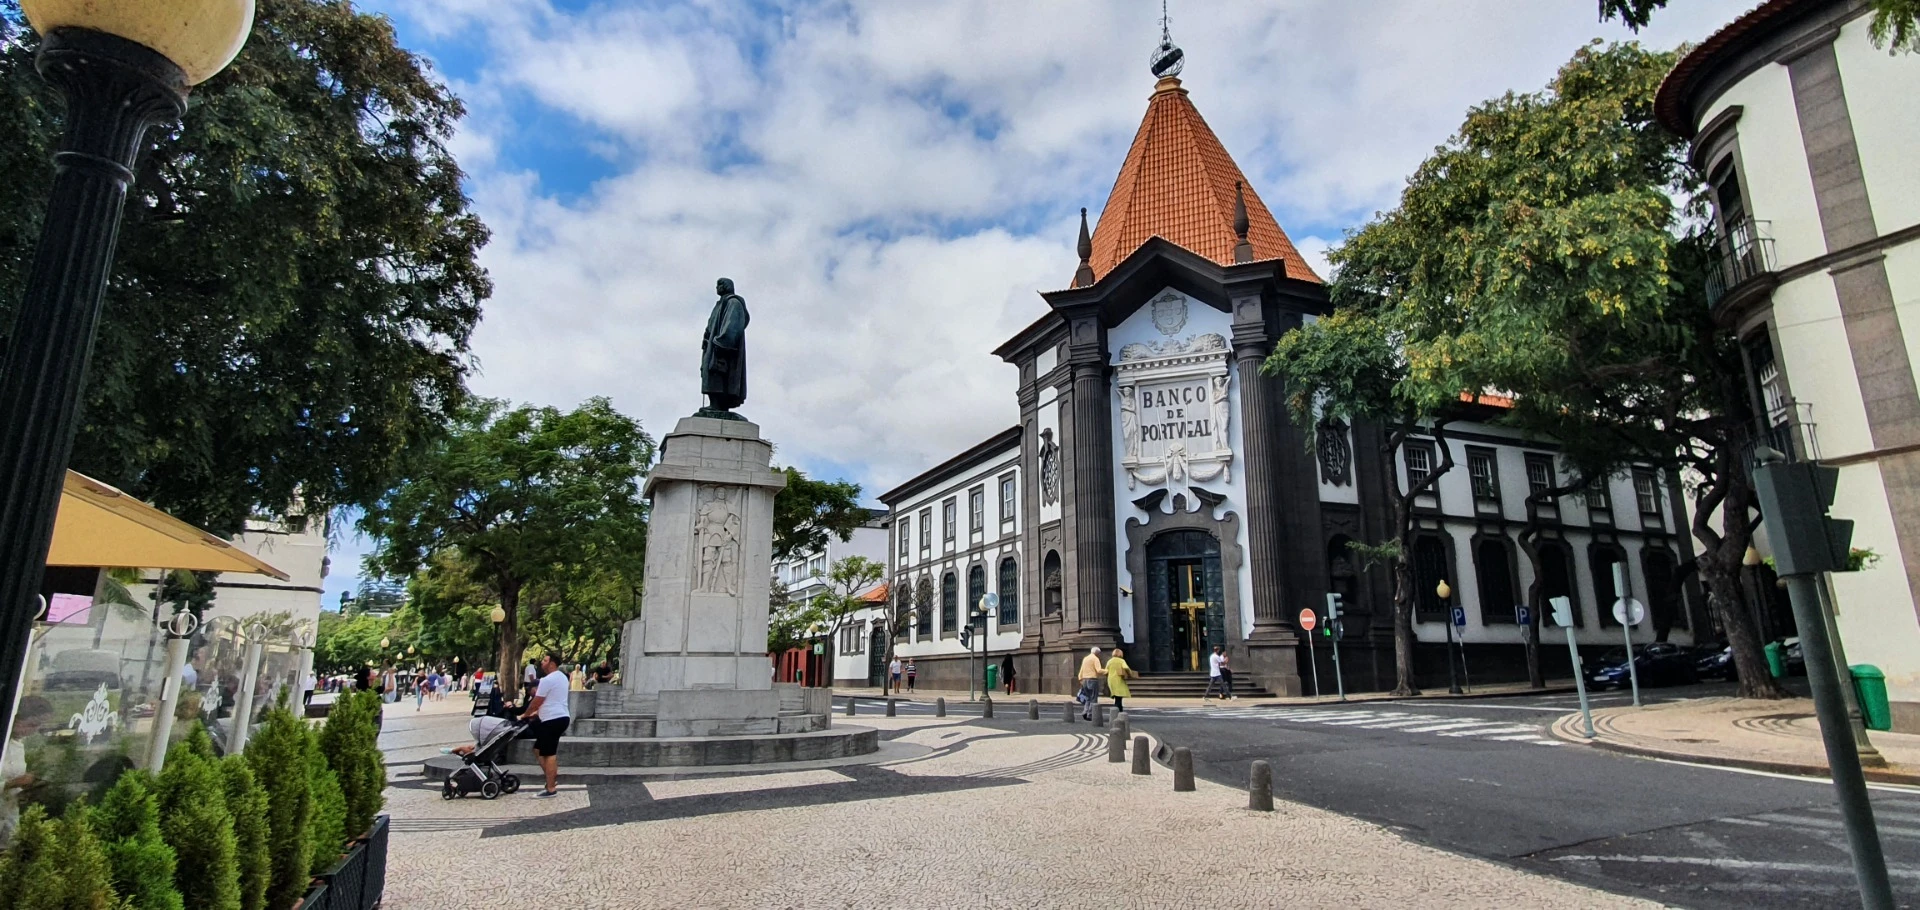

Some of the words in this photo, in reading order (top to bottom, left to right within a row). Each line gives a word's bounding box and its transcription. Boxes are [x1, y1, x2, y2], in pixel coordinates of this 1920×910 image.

[1143, 386, 1206, 408] BANCO
[1167, 409, 1184, 419] DE
[1454, 608, 1462, 624] P
[1519, 608, 1527, 622] P
